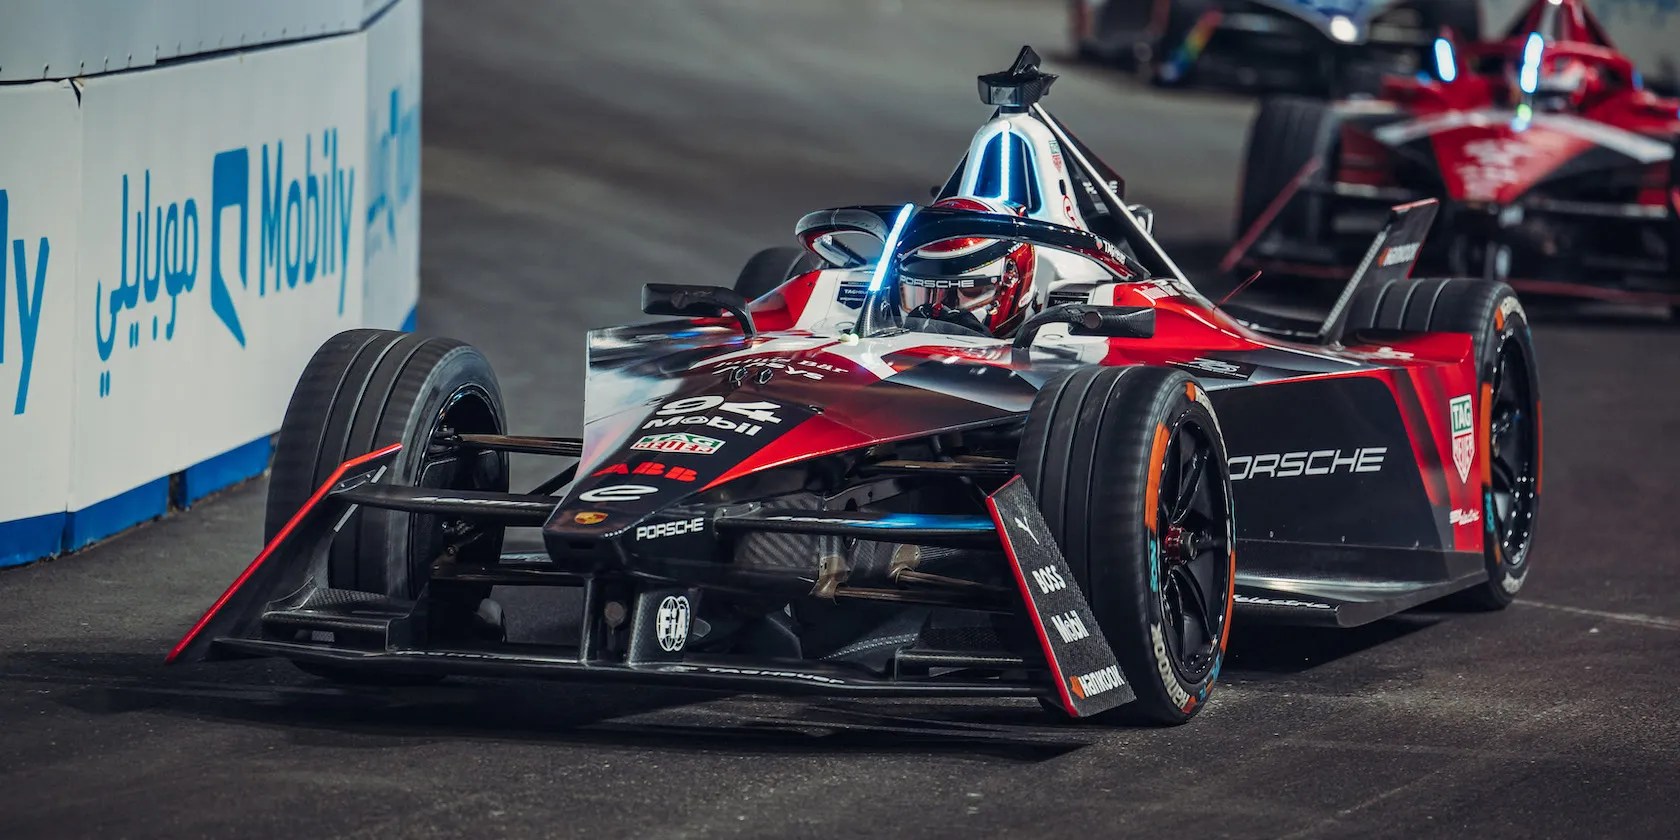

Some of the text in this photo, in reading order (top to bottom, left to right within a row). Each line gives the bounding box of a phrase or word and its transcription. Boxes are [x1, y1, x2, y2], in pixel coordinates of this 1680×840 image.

[260, 128, 355, 316] Mobily
[96, 169, 199, 398] موبايلي
[899, 275, 974, 288] PORSCHE
[656, 395, 782, 424] 94
[1453, 404, 1471, 431] TAG
[642, 414, 763, 437] Mobil
[634, 441, 714, 454] HEUER
[640, 432, 722, 448] TAG
[591, 462, 698, 482] ABB
[1227, 447, 1388, 481] ORSCHE
[636, 518, 704, 541] PORSCHE
[1032, 565, 1067, 595] BOSS
[1051, 610, 1090, 643] Mobil
